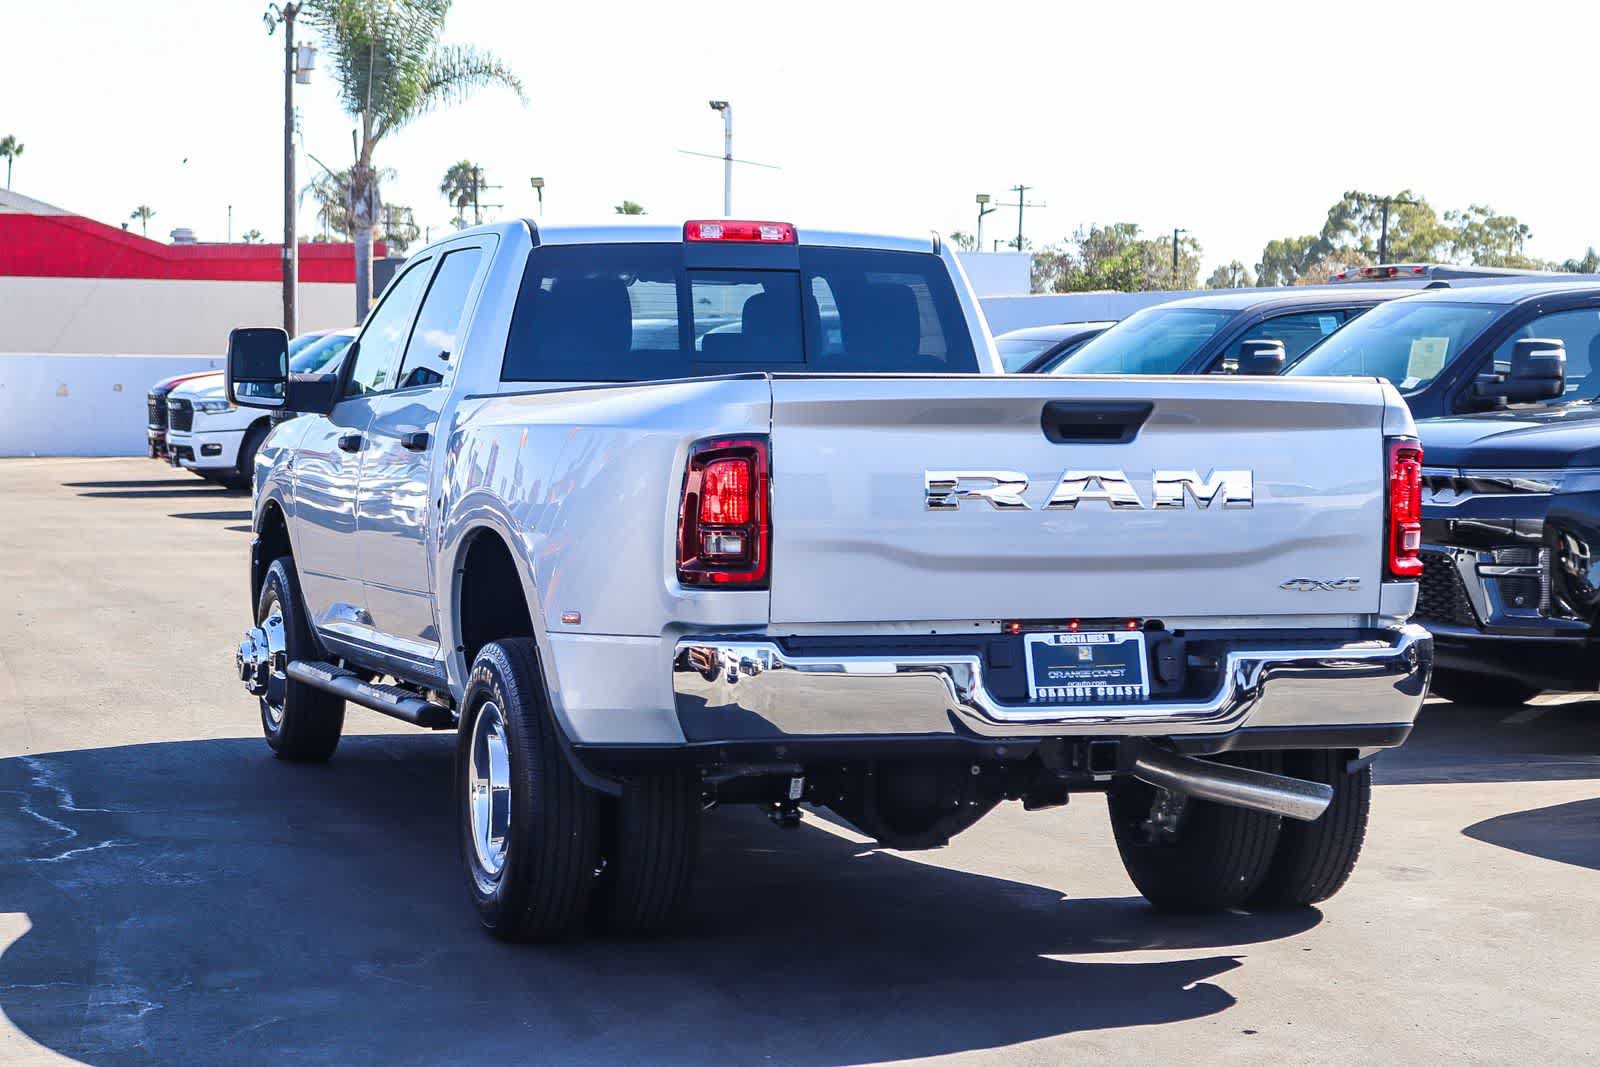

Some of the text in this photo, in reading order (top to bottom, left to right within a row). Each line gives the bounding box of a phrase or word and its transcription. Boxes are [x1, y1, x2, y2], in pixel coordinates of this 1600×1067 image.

[924, 467, 1254, 511] RAM
[1048, 669, 1126, 679] ORANGE COAST
[1038, 686, 1141, 698] ORANGE COAST
